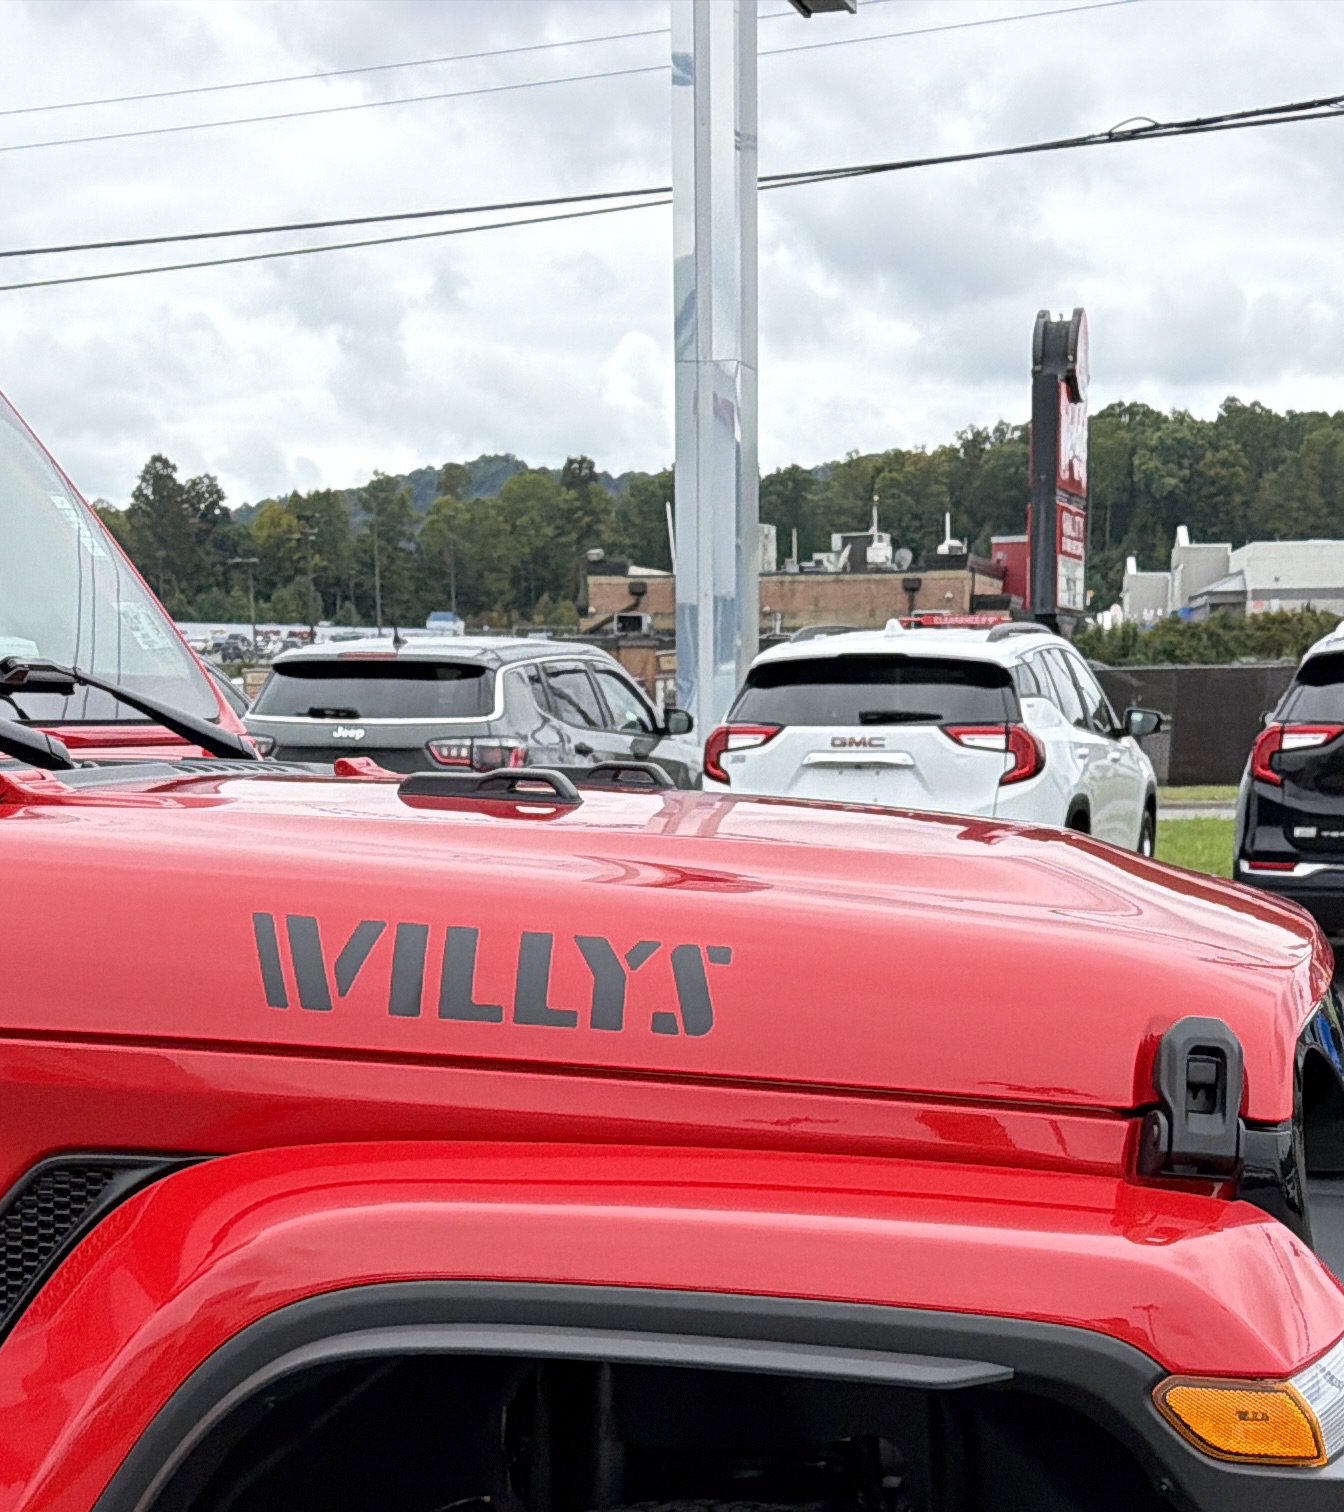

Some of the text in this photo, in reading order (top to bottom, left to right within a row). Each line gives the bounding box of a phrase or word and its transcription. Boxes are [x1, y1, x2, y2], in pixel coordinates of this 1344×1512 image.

[332, 725, 365, 741] Jeep
[830, 736, 886, 748] GMC
[252, 911, 733, 1037] WILLYS
